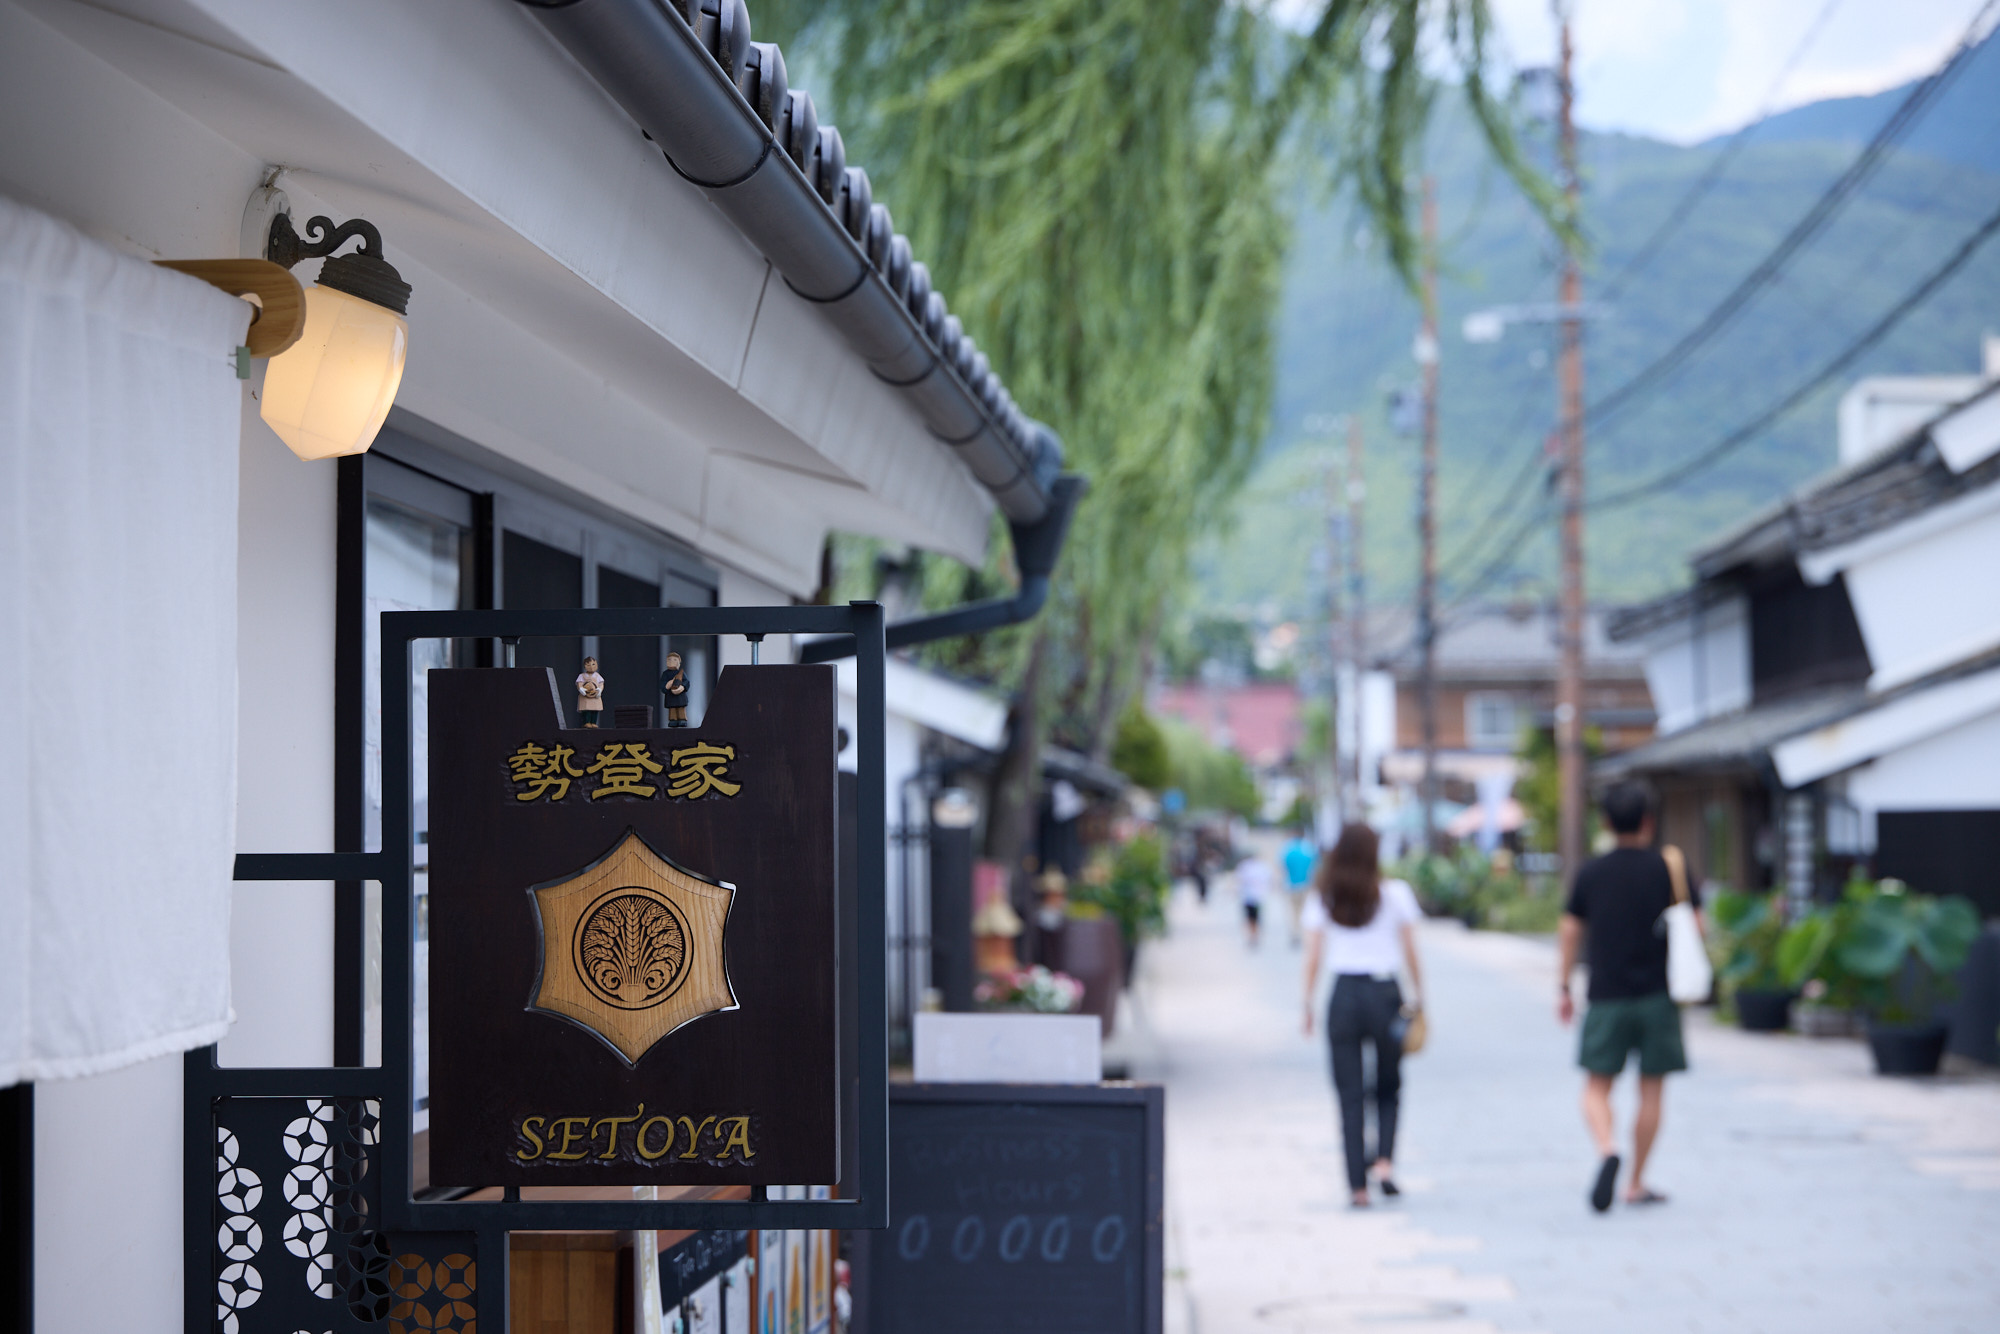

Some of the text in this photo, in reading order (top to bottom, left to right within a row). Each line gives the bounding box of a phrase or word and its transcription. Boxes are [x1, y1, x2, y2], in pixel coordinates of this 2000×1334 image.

[508, 741, 741, 801] 勢登家
[516, 1102, 756, 1160] SETOYA
